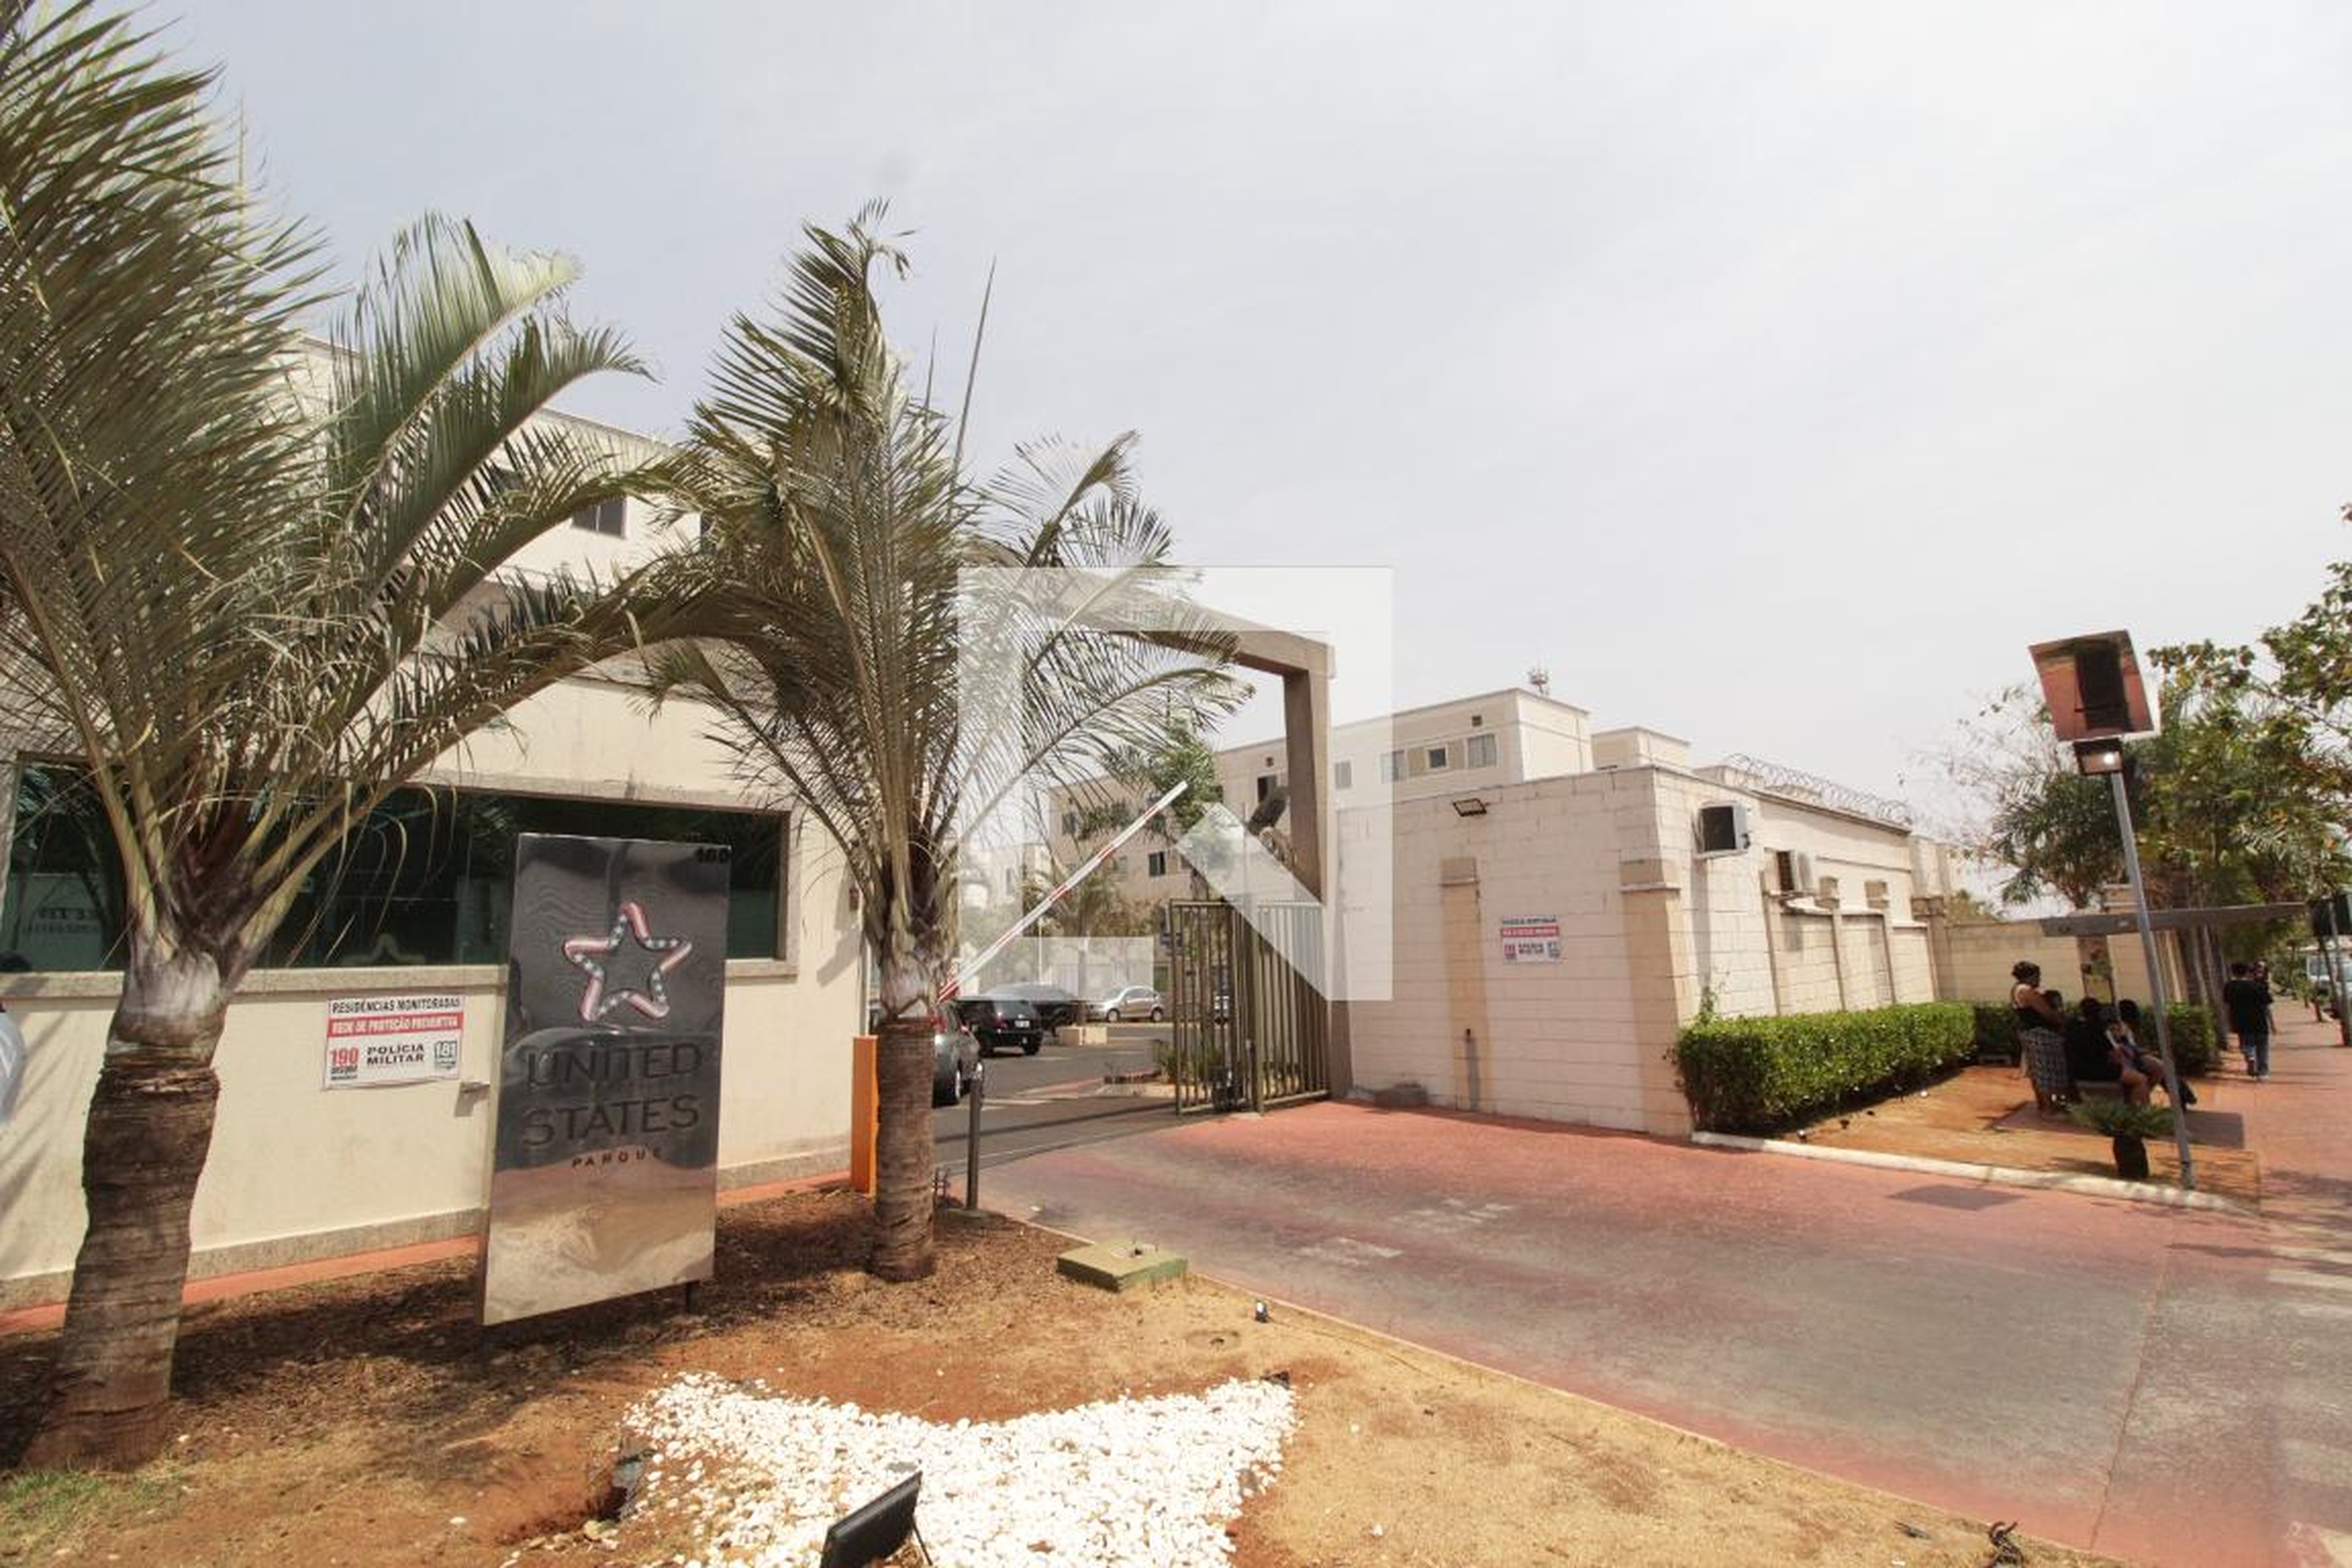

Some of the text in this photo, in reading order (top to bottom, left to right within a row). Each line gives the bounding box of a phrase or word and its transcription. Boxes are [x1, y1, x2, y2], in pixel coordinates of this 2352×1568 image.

[396, 998, 459, 1011] MONITORADAS
[331, 1047, 359, 1065] 190
[367, 1054, 424, 1065] MILITAR
[528, 1043, 702, 1086] UNITED
[521, 1094, 699, 1145] STATES
